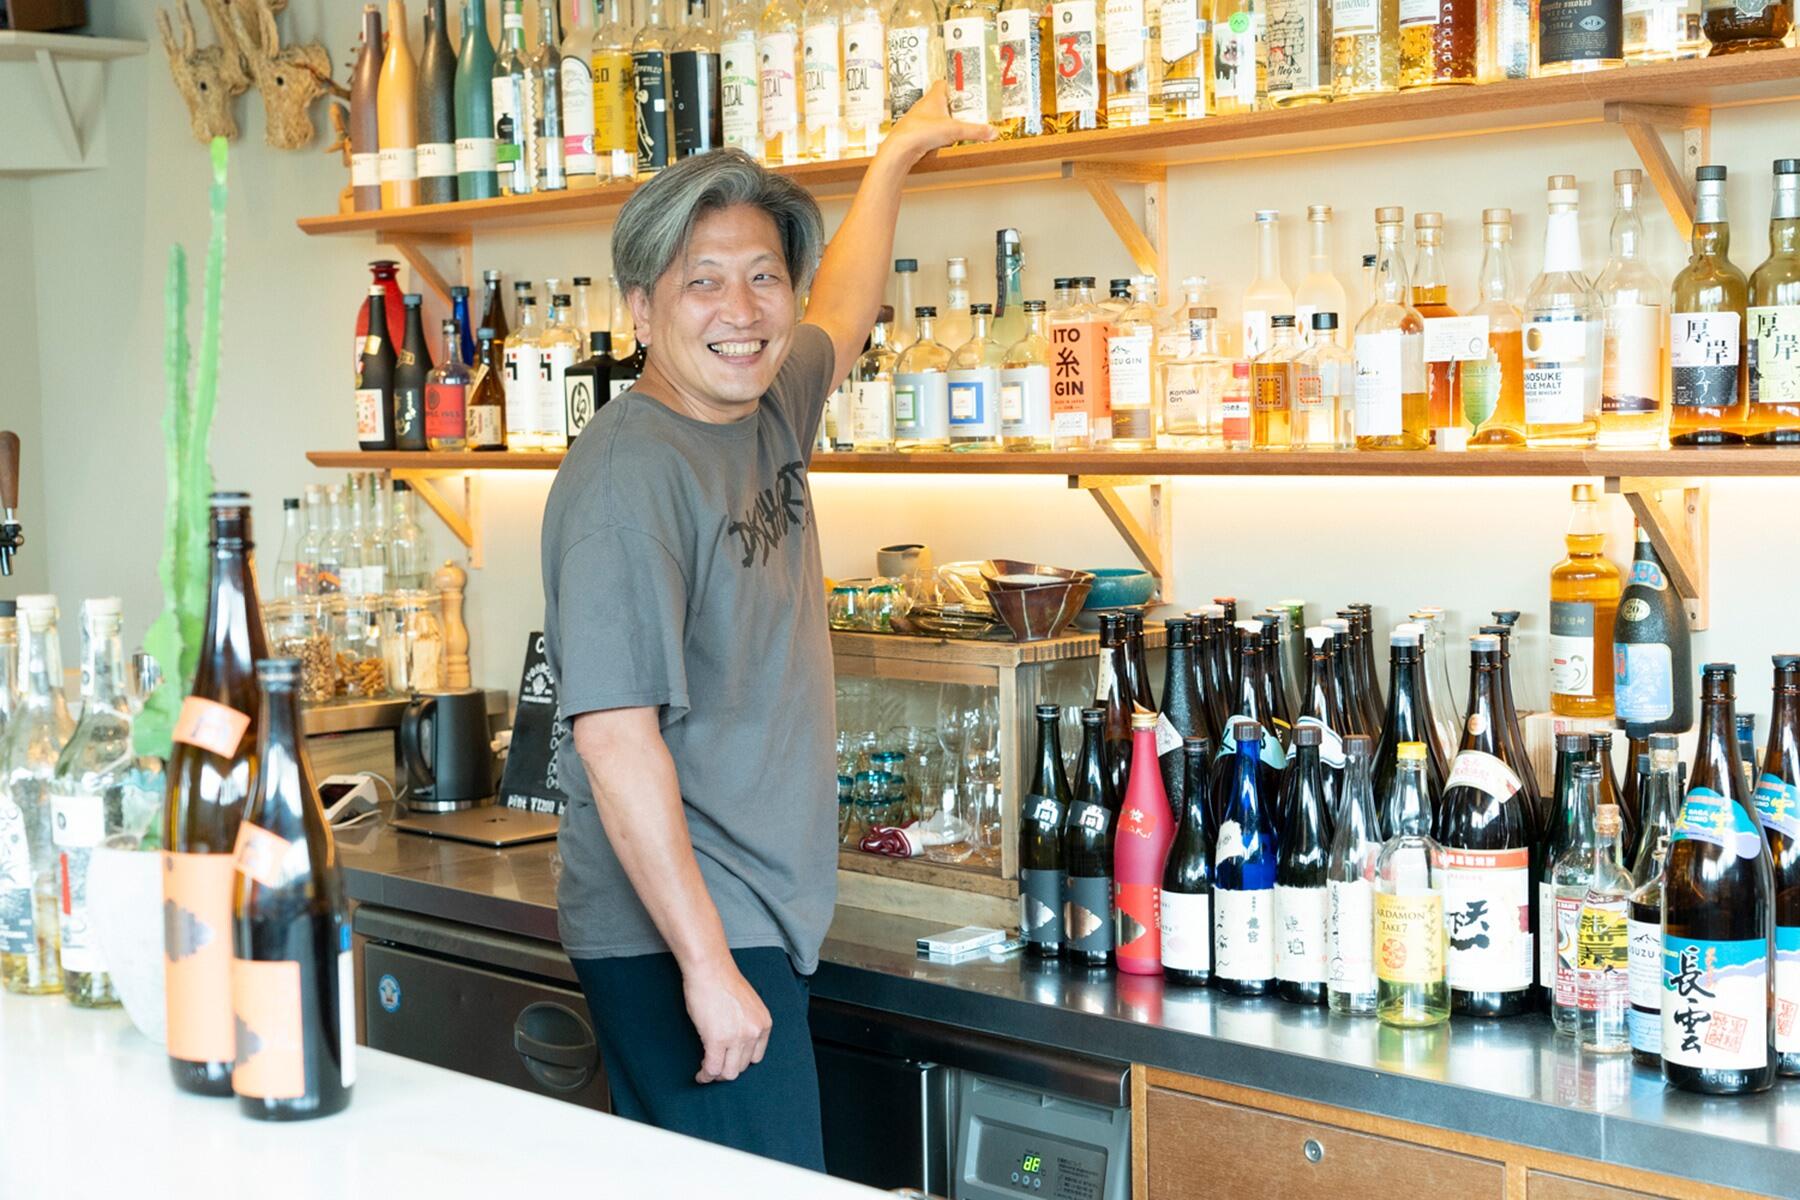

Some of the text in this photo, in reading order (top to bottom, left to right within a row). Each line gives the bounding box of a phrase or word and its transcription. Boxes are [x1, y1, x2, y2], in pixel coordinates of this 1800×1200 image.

[1000, 44, 1017, 86] 2
[1059, 36, 1083, 78] 3
[954, 51, 964, 91] 1
[1053, 328, 1081, 343] ITO
[1056, 347, 1080, 378] 糸
[1524, 372, 1562, 381] NOSUKE
[1055, 381, 1084, 396] GIN
[1376, 908, 1425, 920] ARDAMON
[1628, 946, 1655, 958] SUZU
[1670, 946, 1716, 1053] 長雲
